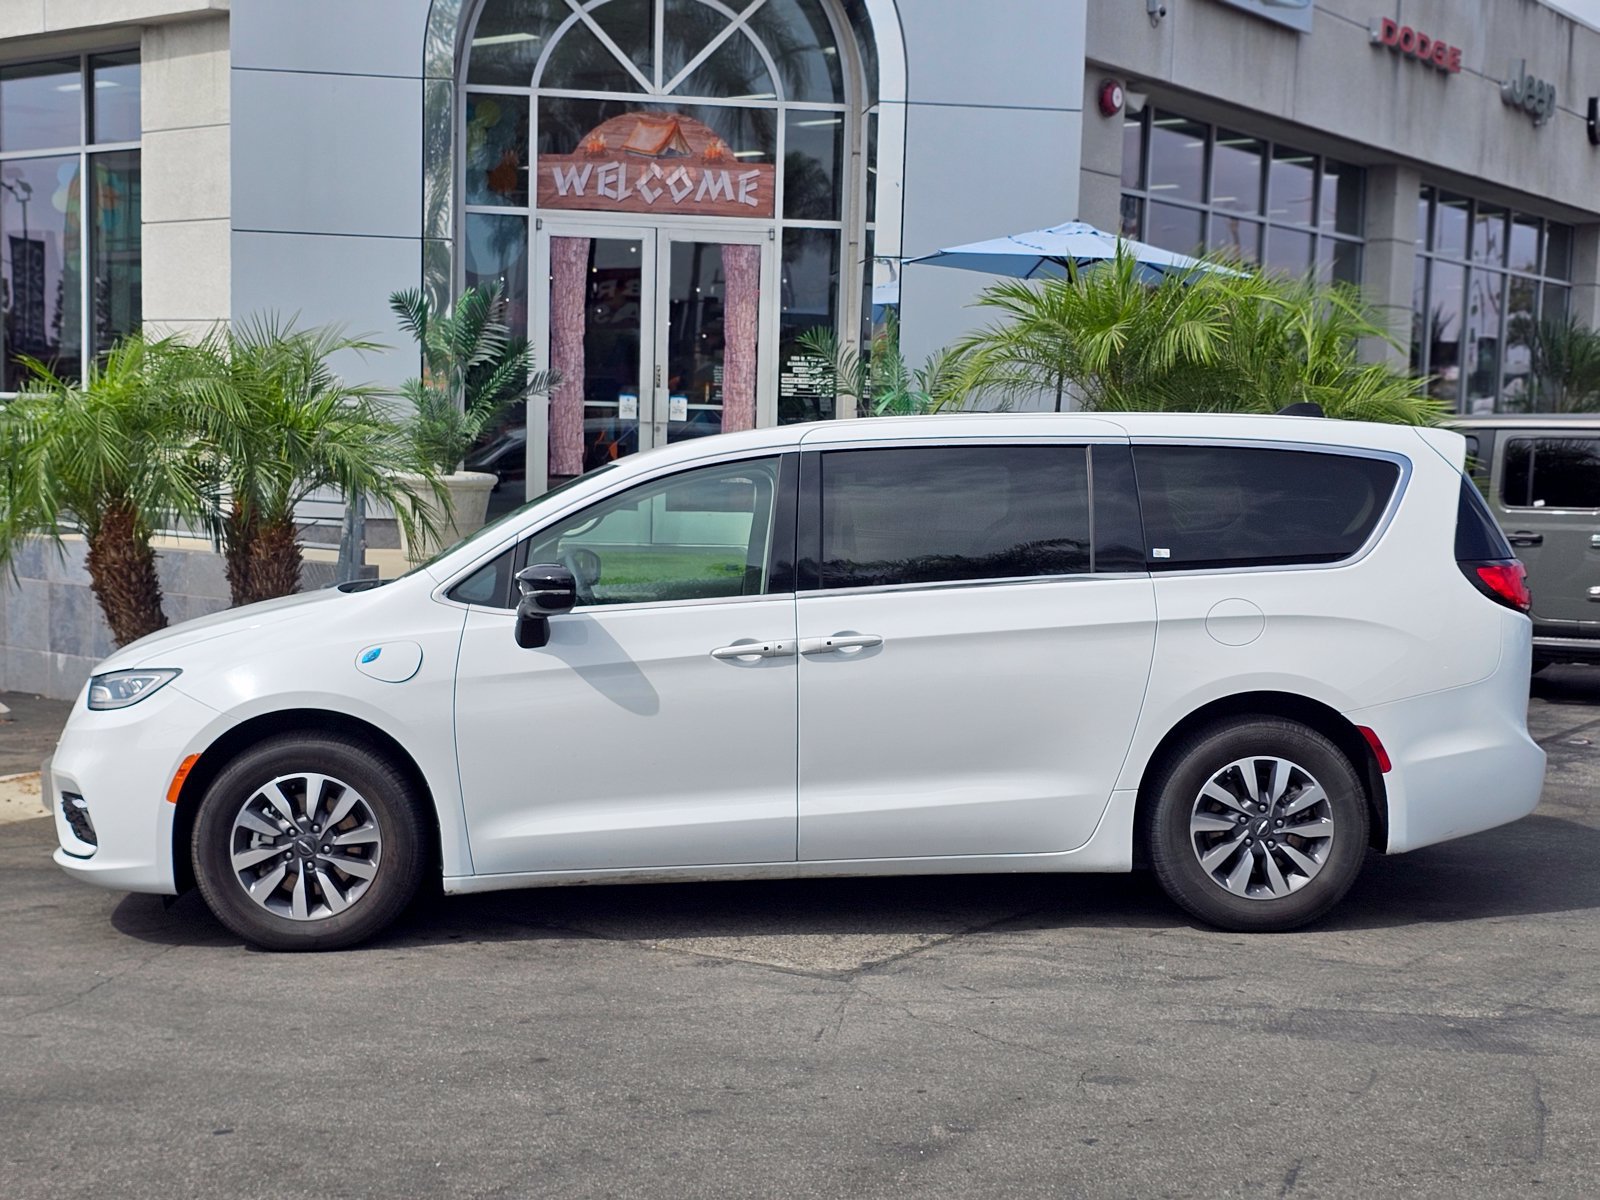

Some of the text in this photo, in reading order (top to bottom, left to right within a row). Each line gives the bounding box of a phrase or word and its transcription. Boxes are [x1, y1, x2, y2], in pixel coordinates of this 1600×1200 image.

[1380, 17, 1462, 74] DODGE
[1509, 57, 1556, 124] Jeep
[552, 160, 761, 208] WELCOME
